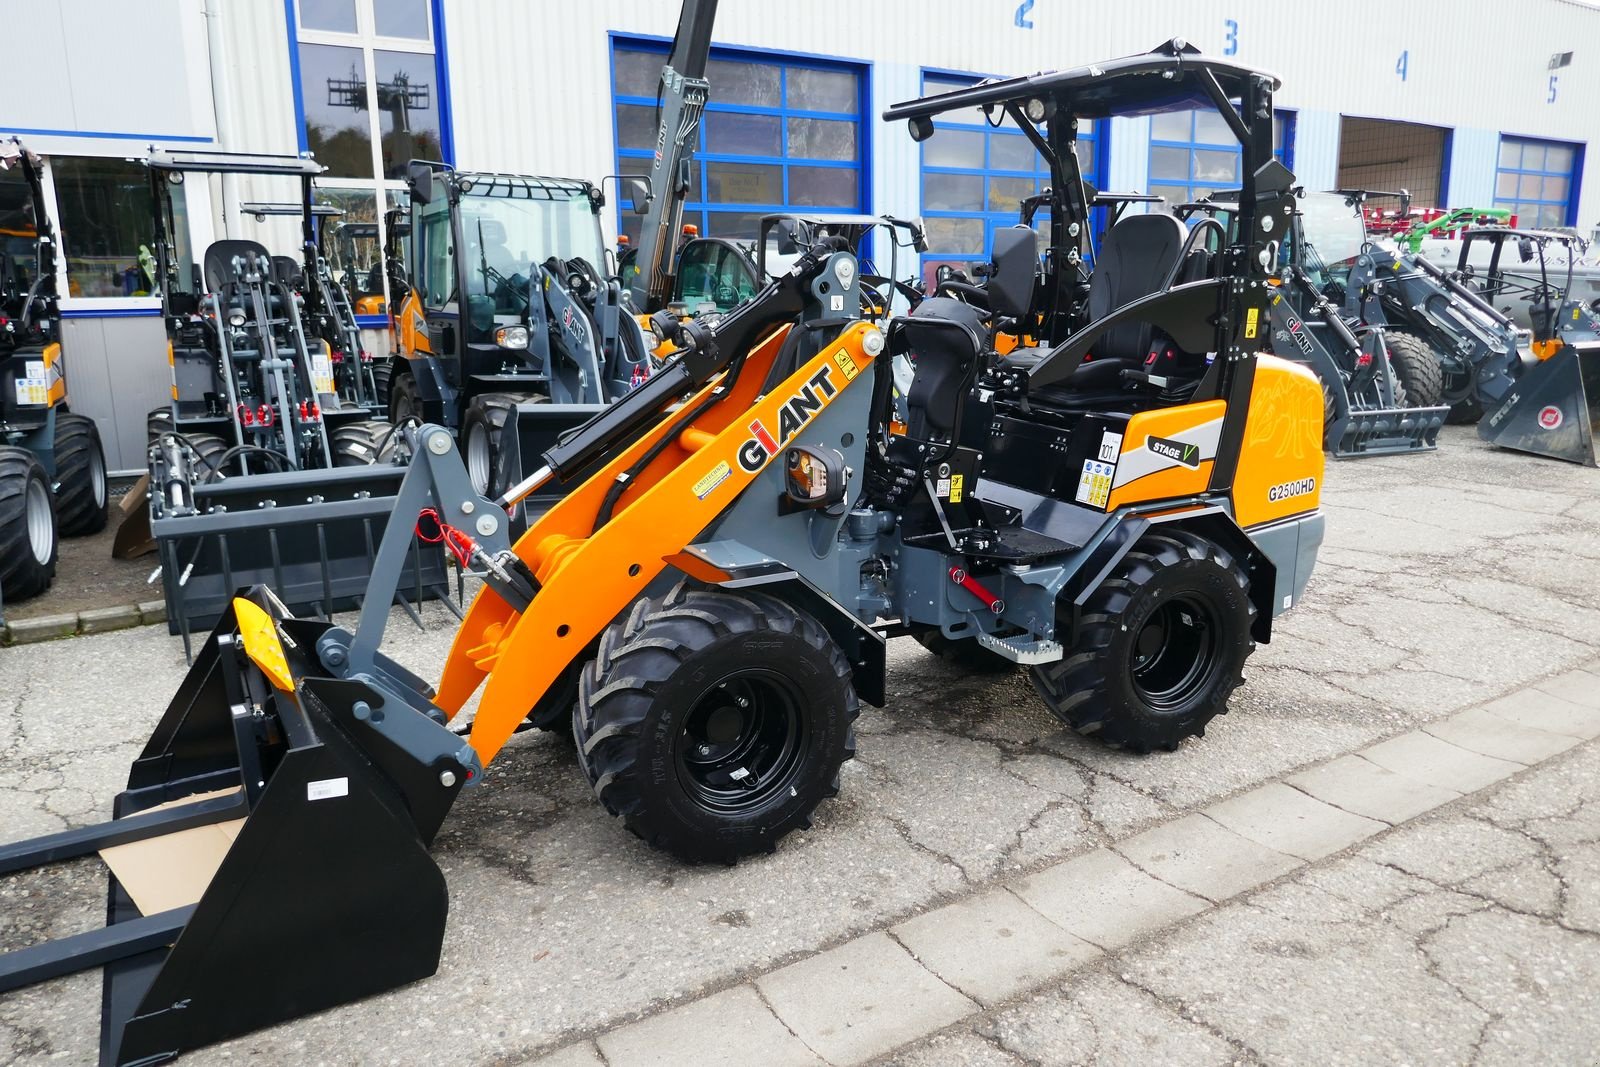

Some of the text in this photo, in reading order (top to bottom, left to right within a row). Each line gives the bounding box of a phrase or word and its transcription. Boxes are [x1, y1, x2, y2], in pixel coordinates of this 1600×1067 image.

[1014, 0, 1034, 29] 2
[1222, 19, 1238, 56] 3
[1396, 50, 1408, 82] 4
[1547, 75, 1558, 104] 5
[1101, 444, 1113, 460] 101
[1153, 442, 1198, 462] STAGE V
[1268, 478, 1316, 502] G2500HD
